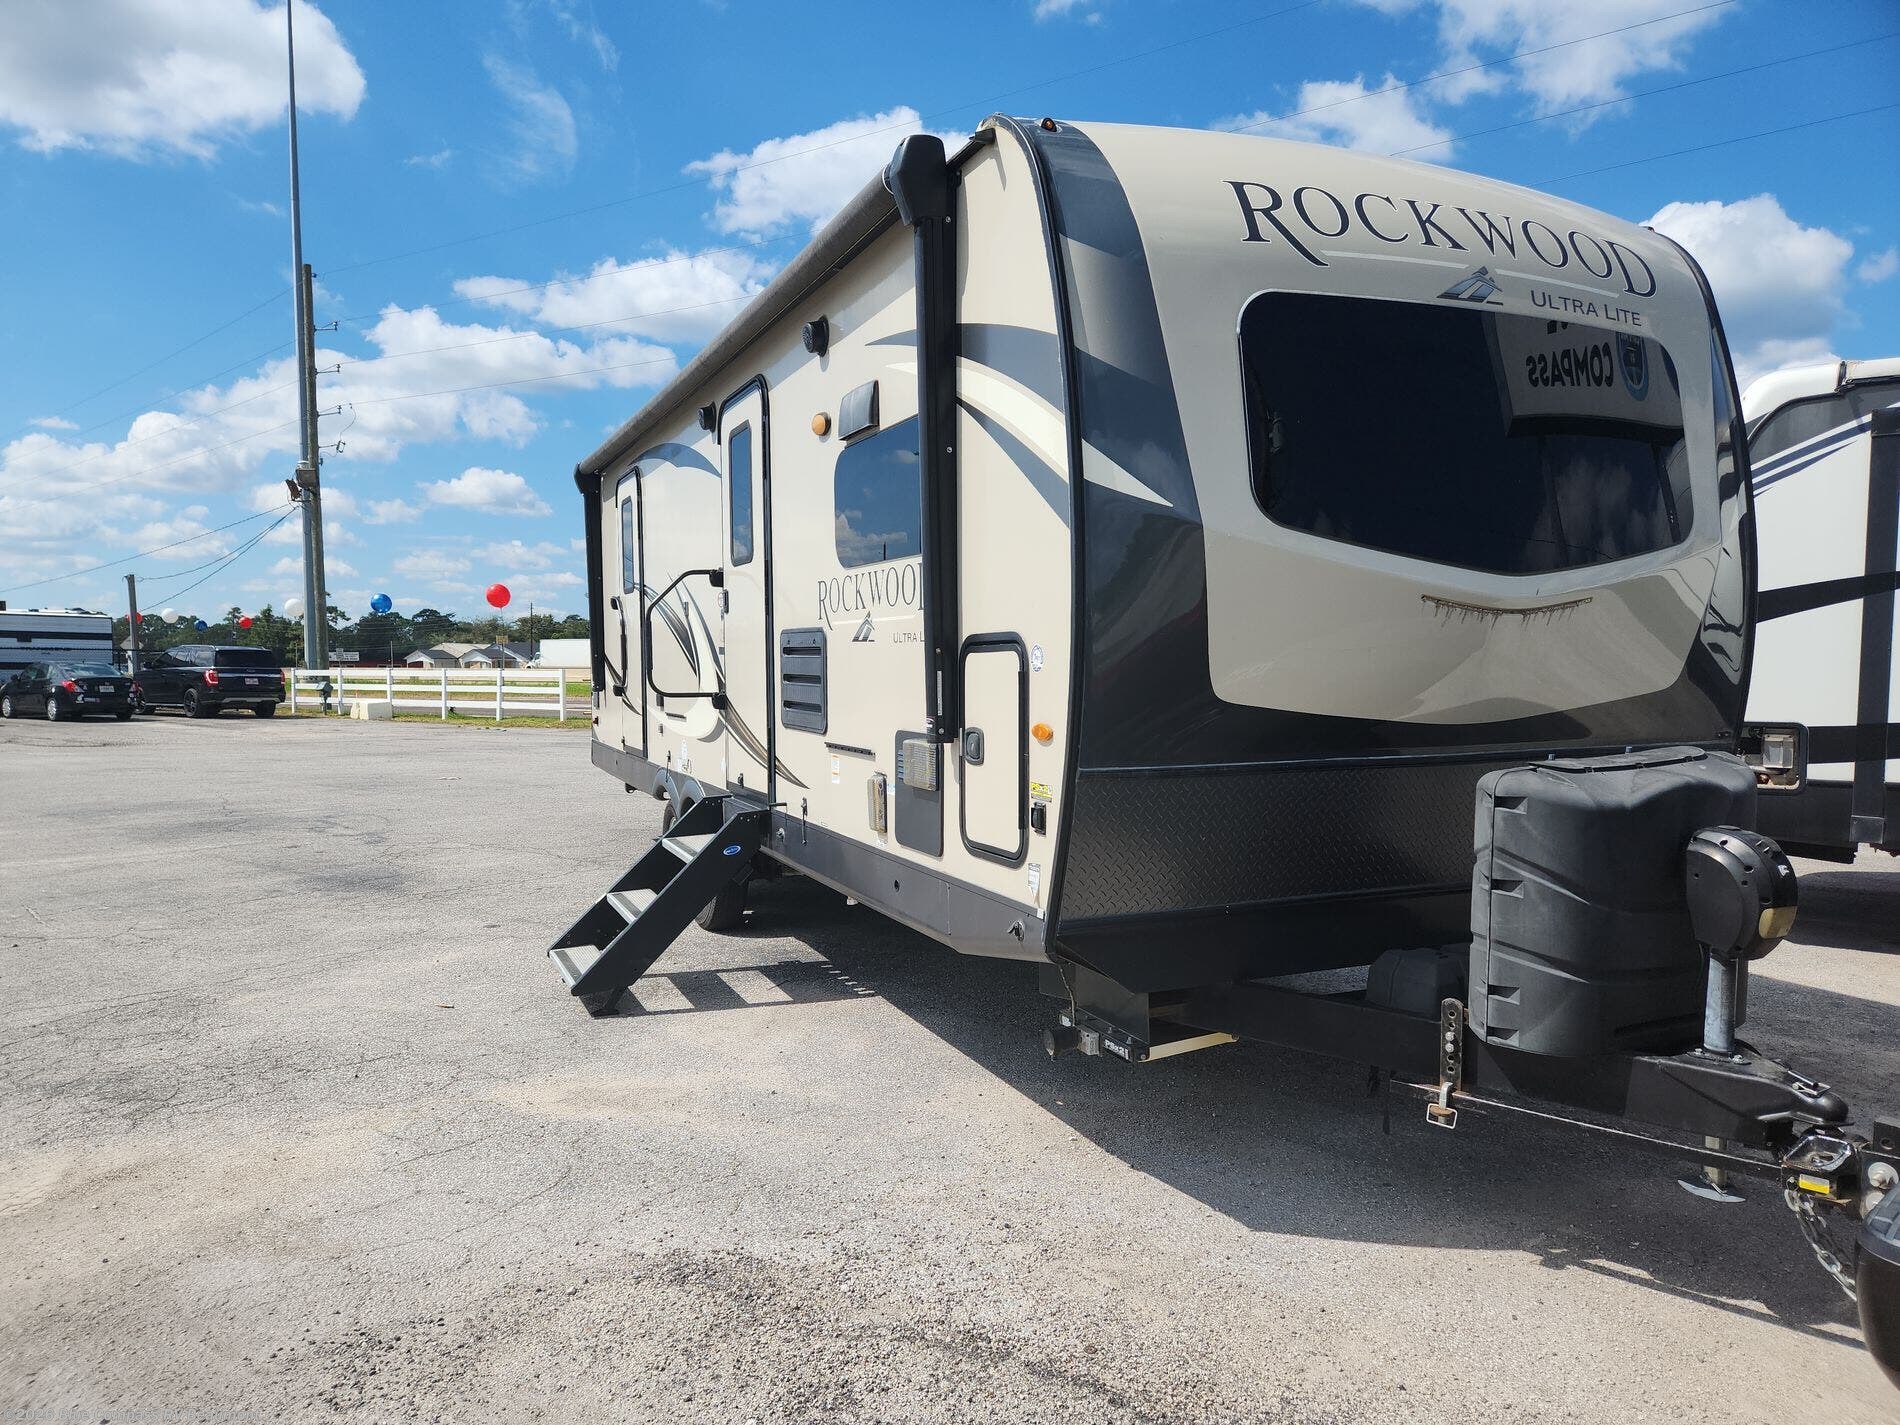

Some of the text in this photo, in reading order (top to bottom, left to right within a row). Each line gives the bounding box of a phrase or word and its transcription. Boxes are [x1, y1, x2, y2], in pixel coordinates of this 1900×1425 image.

[1223, 180, 1656, 298] ROCKWOOD
[1531, 290, 1642, 327] ULTRA LITE
[892, 632, 918, 644] ULTRA
